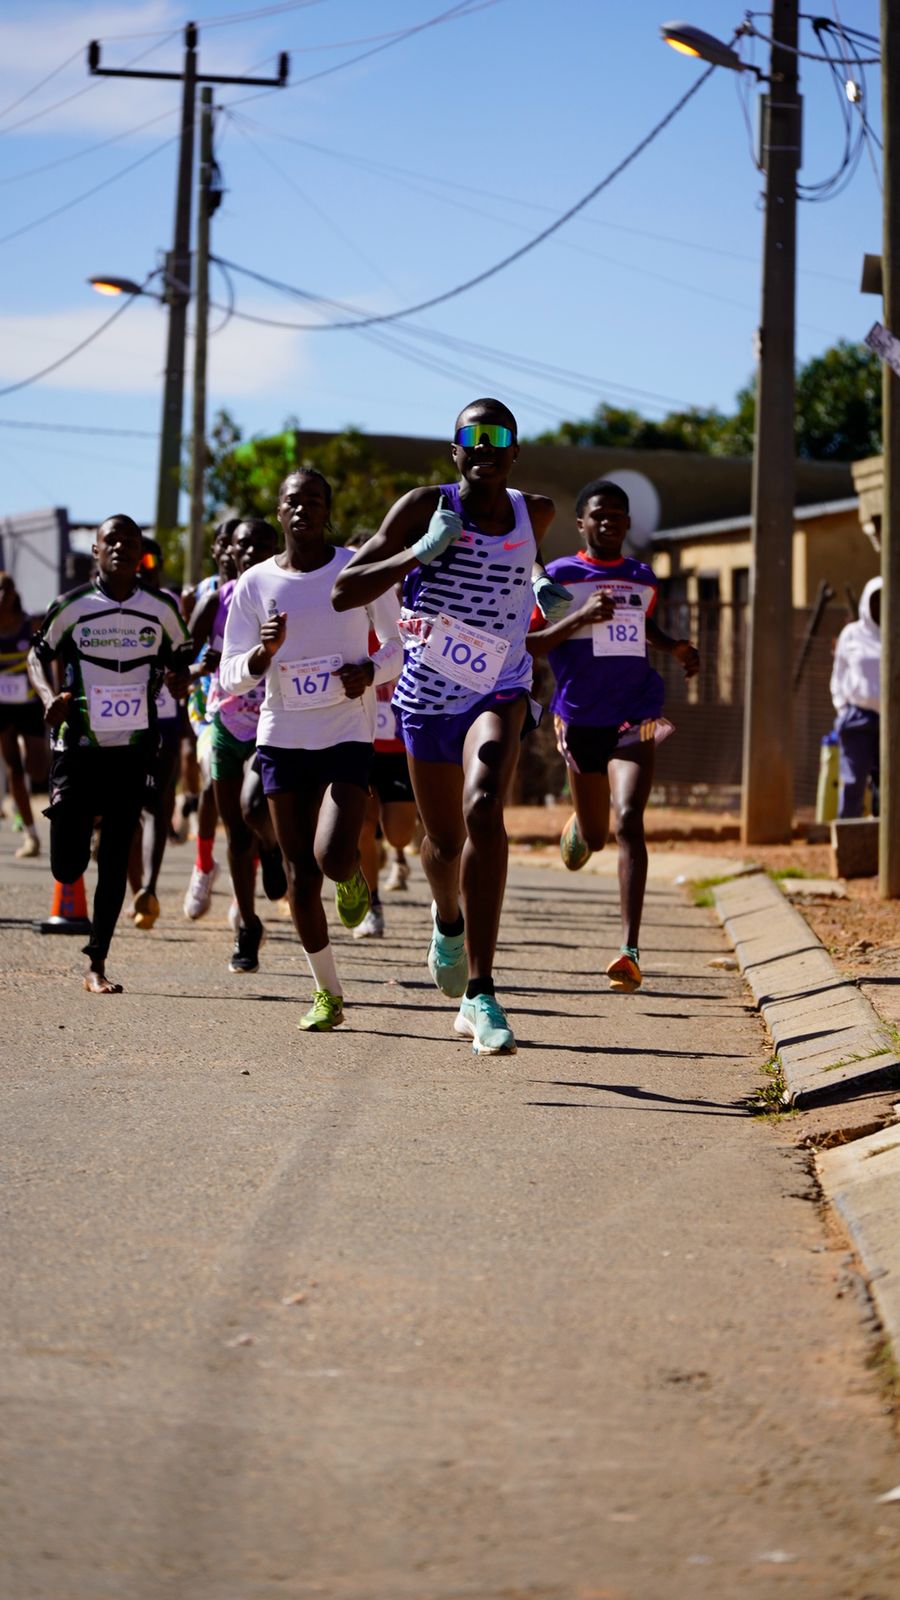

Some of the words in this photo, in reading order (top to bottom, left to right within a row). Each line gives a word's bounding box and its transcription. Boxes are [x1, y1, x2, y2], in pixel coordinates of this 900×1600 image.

[606, 624, 638, 642] 182
[441, 635, 487, 673] 106
[291, 672, 330, 695] 167
[101, 699, 141, 717] 207
